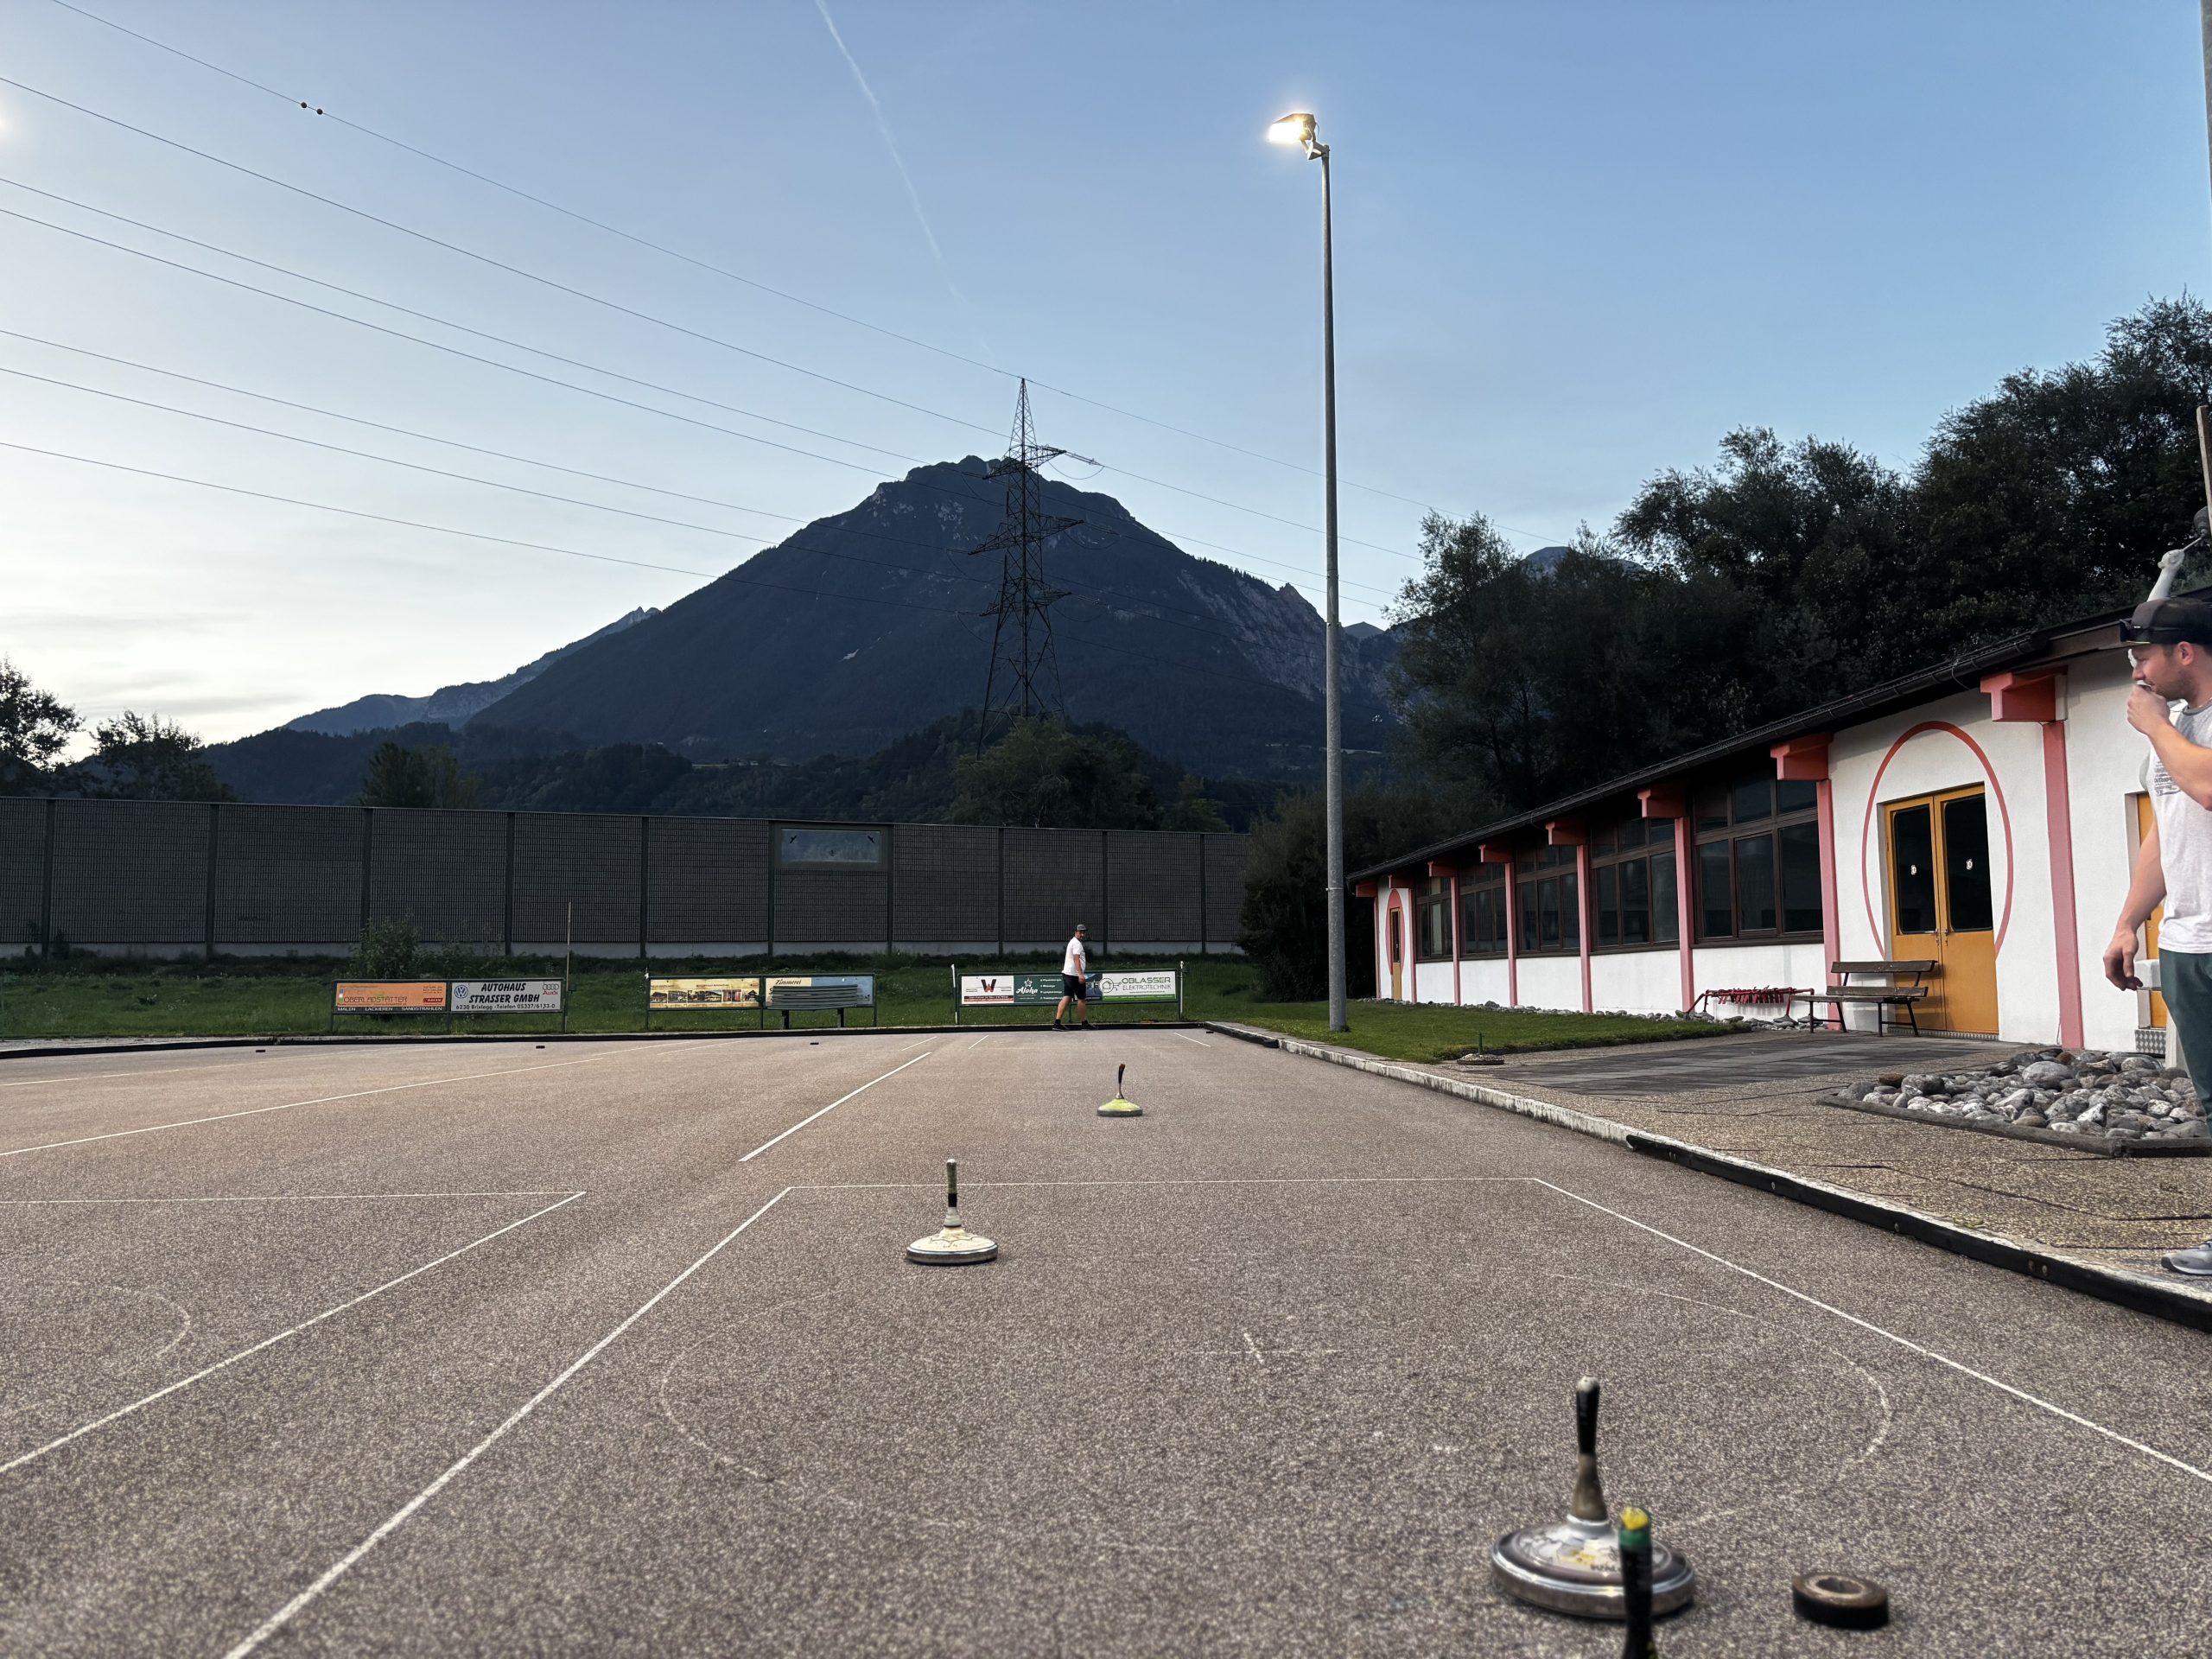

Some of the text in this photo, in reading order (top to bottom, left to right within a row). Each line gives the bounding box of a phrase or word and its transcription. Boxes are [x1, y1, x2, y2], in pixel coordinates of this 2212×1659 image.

[481, 982, 526, 992] AUTOHAUS
[1016, 986, 1039, 995] Aloha
[469, 994, 540, 1003] STRASSER GMBH
